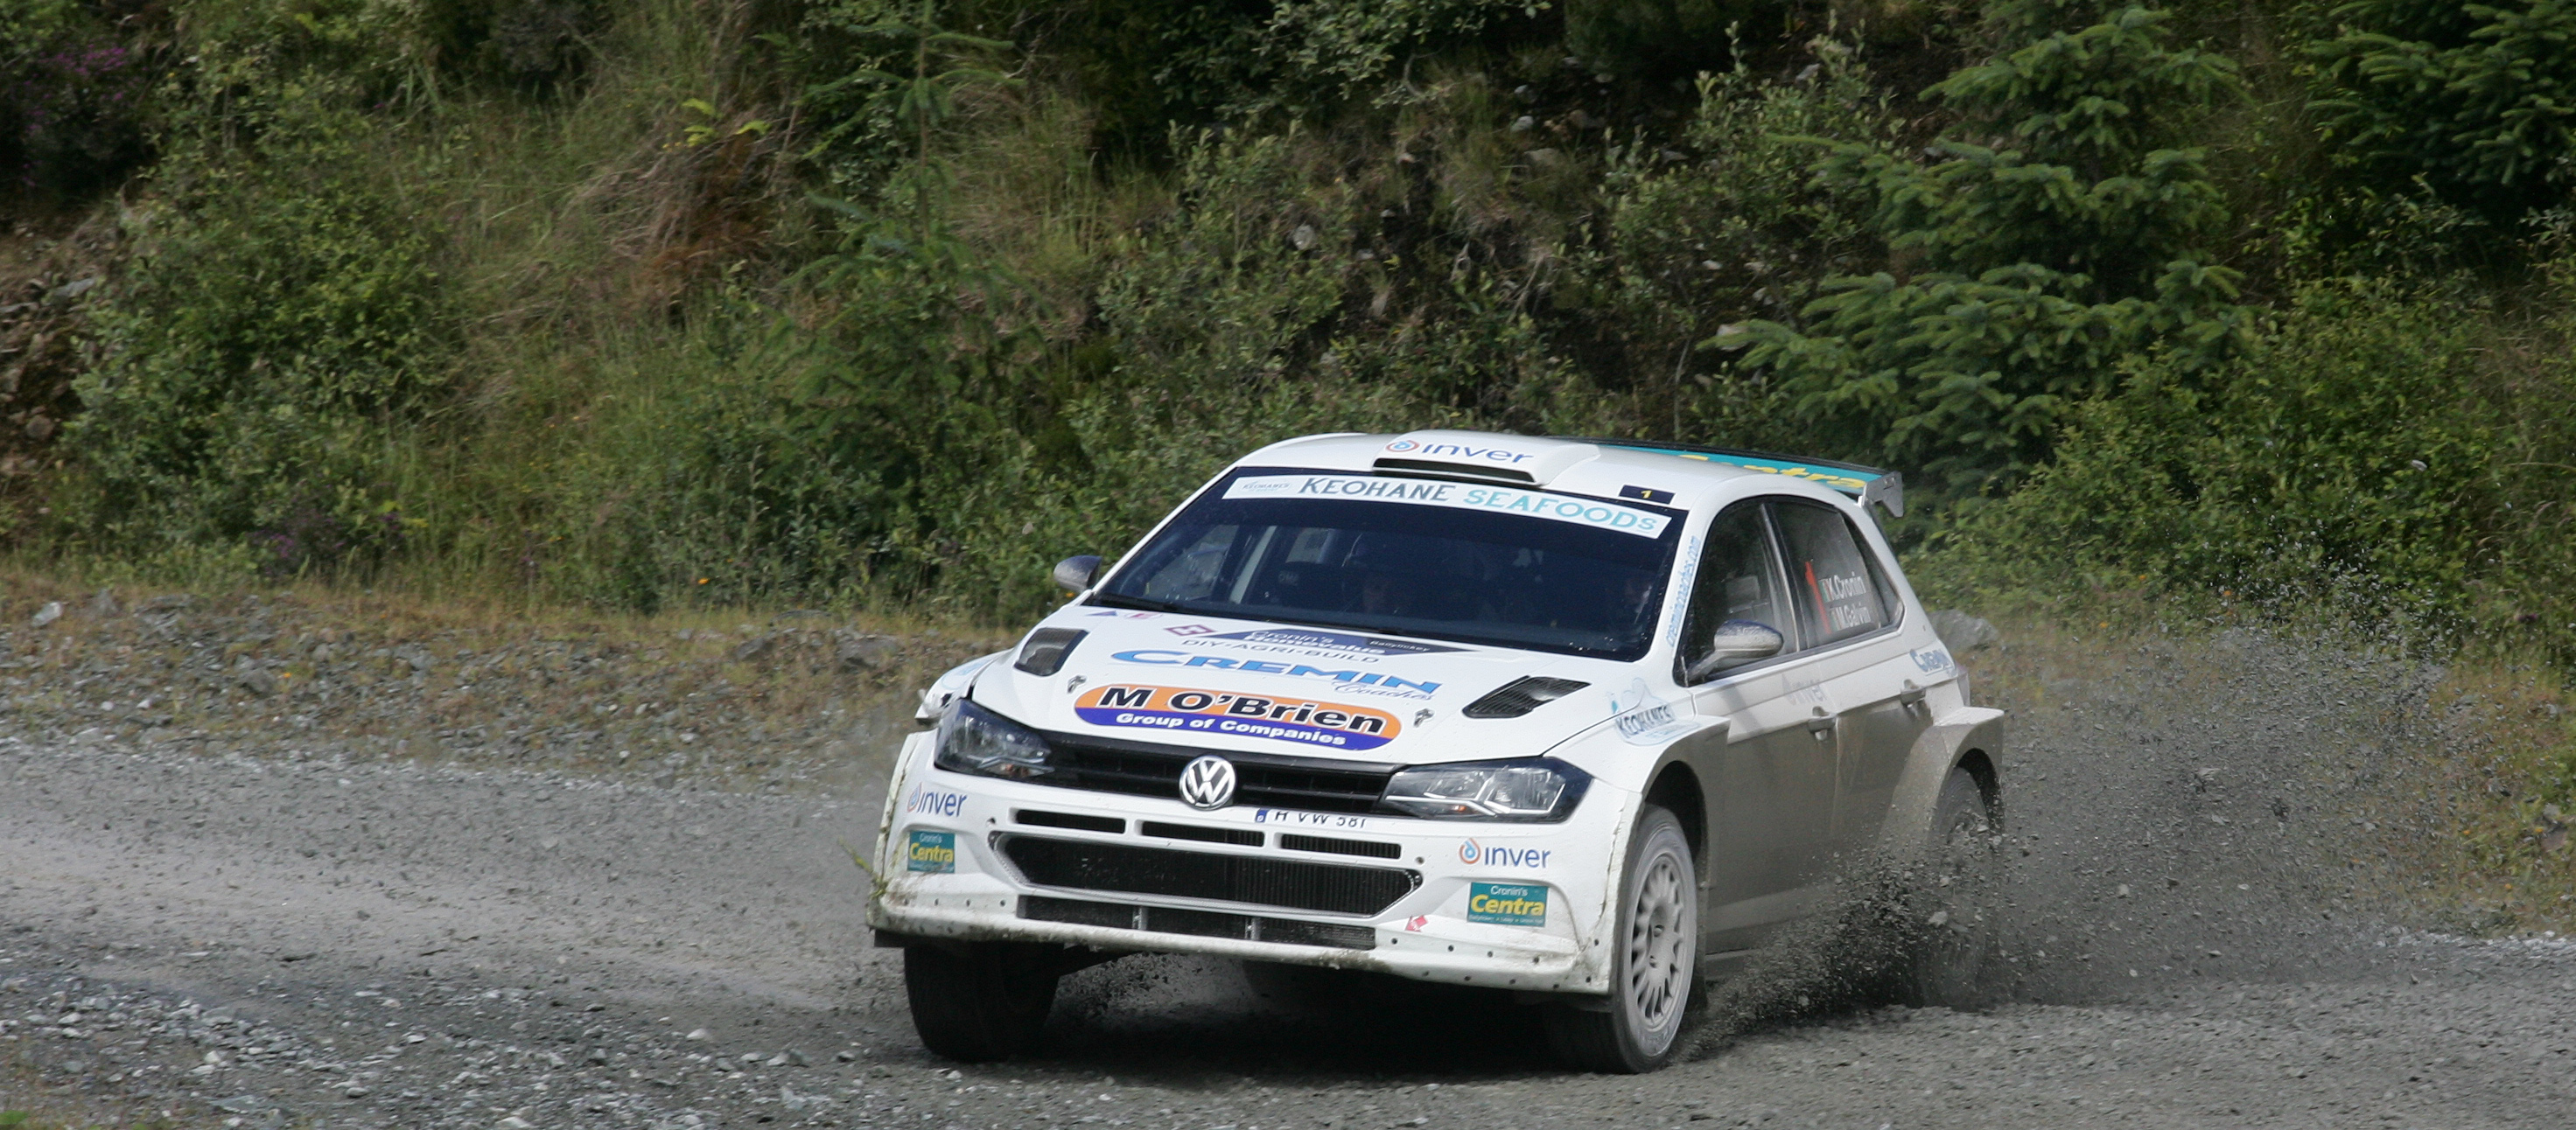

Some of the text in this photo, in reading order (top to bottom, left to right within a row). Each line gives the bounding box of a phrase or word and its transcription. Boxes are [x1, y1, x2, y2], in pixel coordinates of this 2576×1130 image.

[1422, 443, 1534, 464] inver
[1298, 478, 1457, 502] KEOHANE
[1641, 490, 1653, 499] 1
[1111, 649, 1442, 694] CREMIN
[1100, 687, 1154, 708] M
[1116, 713, 1348, 747] Group of Companies
[917, 791, 968, 818] inver
[910, 842, 954, 863] Centra
[1484, 847, 1551, 868] inver
[1490, 885, 1529, 897] Cronin's
[1471, 894, 1545, 917] Centra
